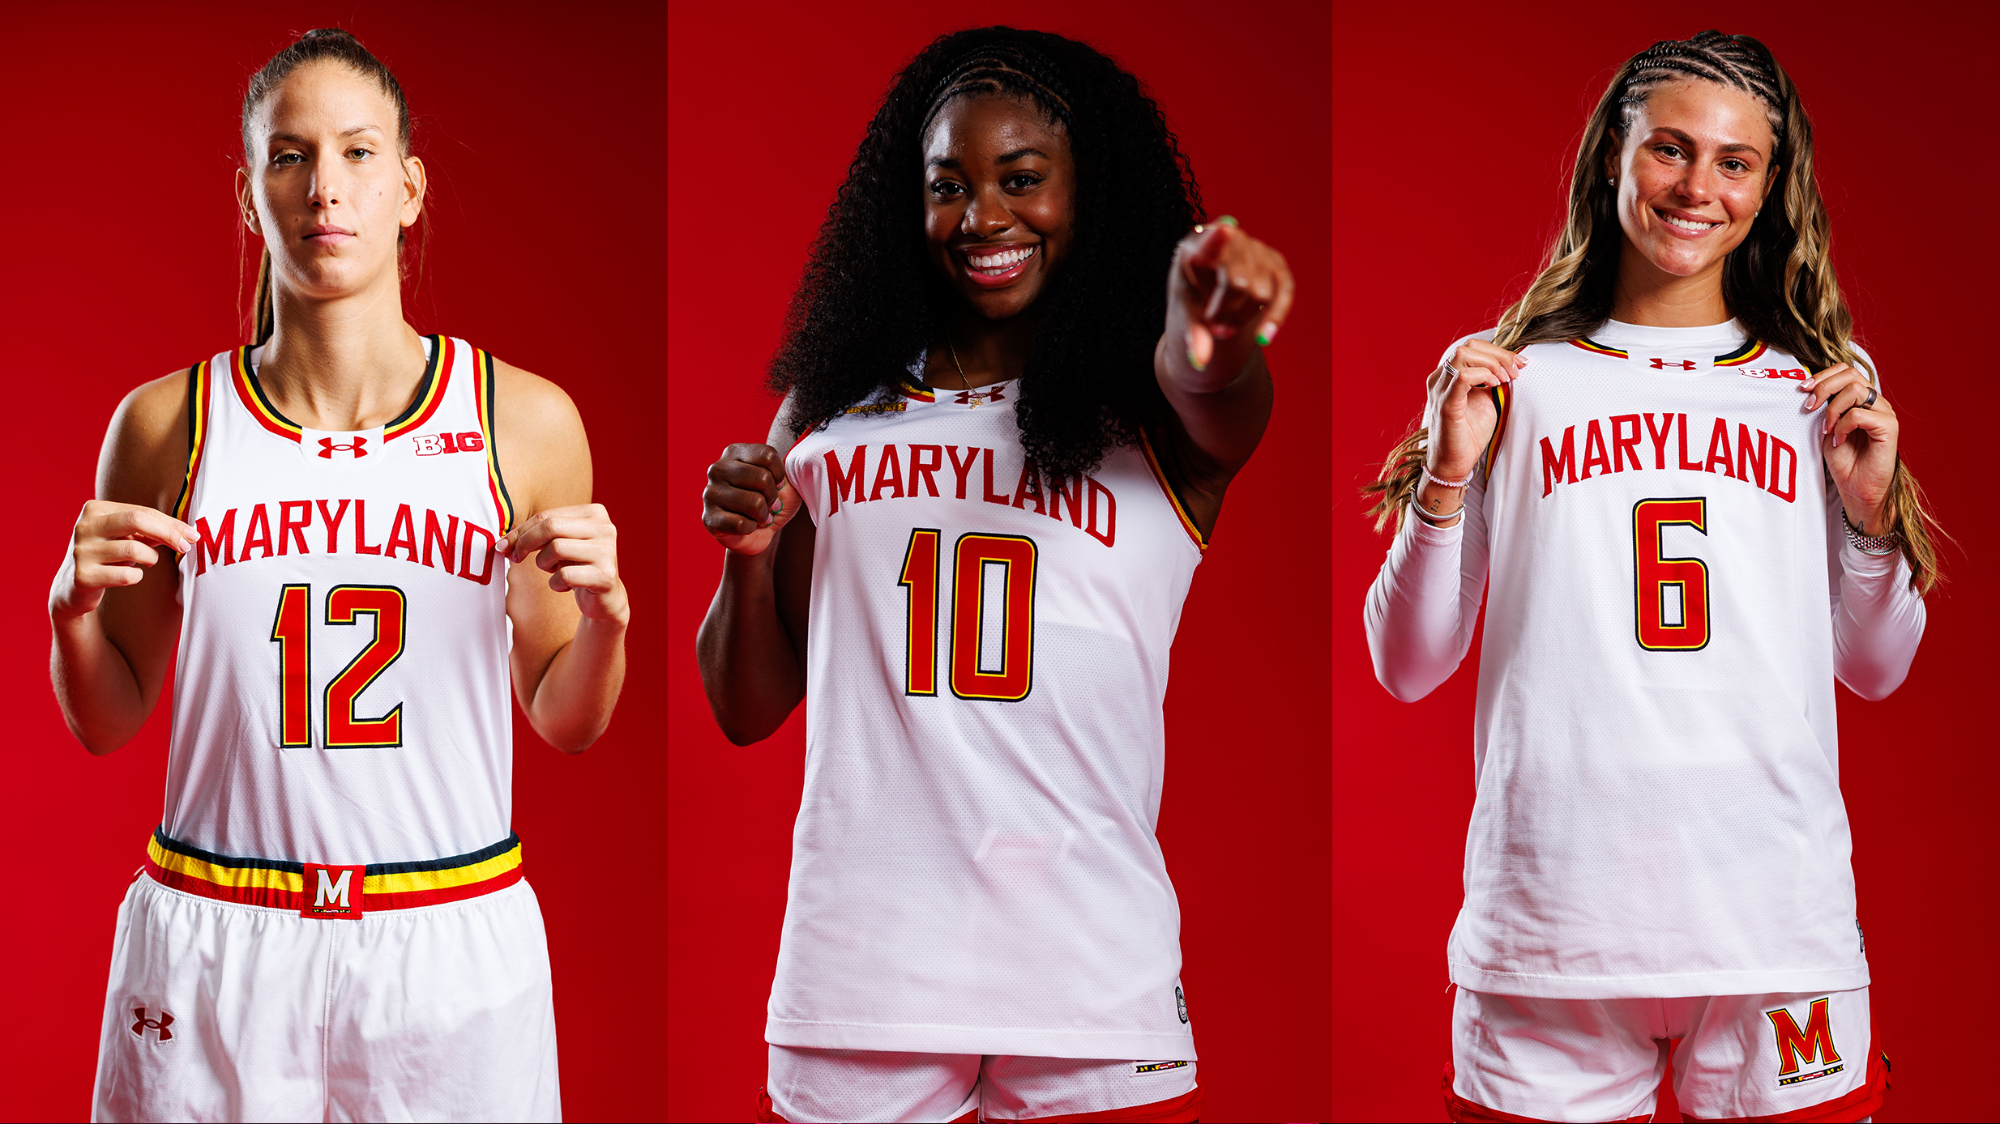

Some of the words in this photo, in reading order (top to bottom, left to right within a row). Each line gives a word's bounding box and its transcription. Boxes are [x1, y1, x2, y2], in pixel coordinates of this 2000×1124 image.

[823, 443, 1117, 548] MARYLAND
[1540, 412, 1798, 504] MARYLAND
[194, 498, 497, 586] MARYLAND
[1632, 496, 1711, 653] 6
[897, 527, 1039, 703] 10
[270, 583, 408, 750] 12
[312, 868, 354, 908] M
[1765, 997, 1843, 1077] M
